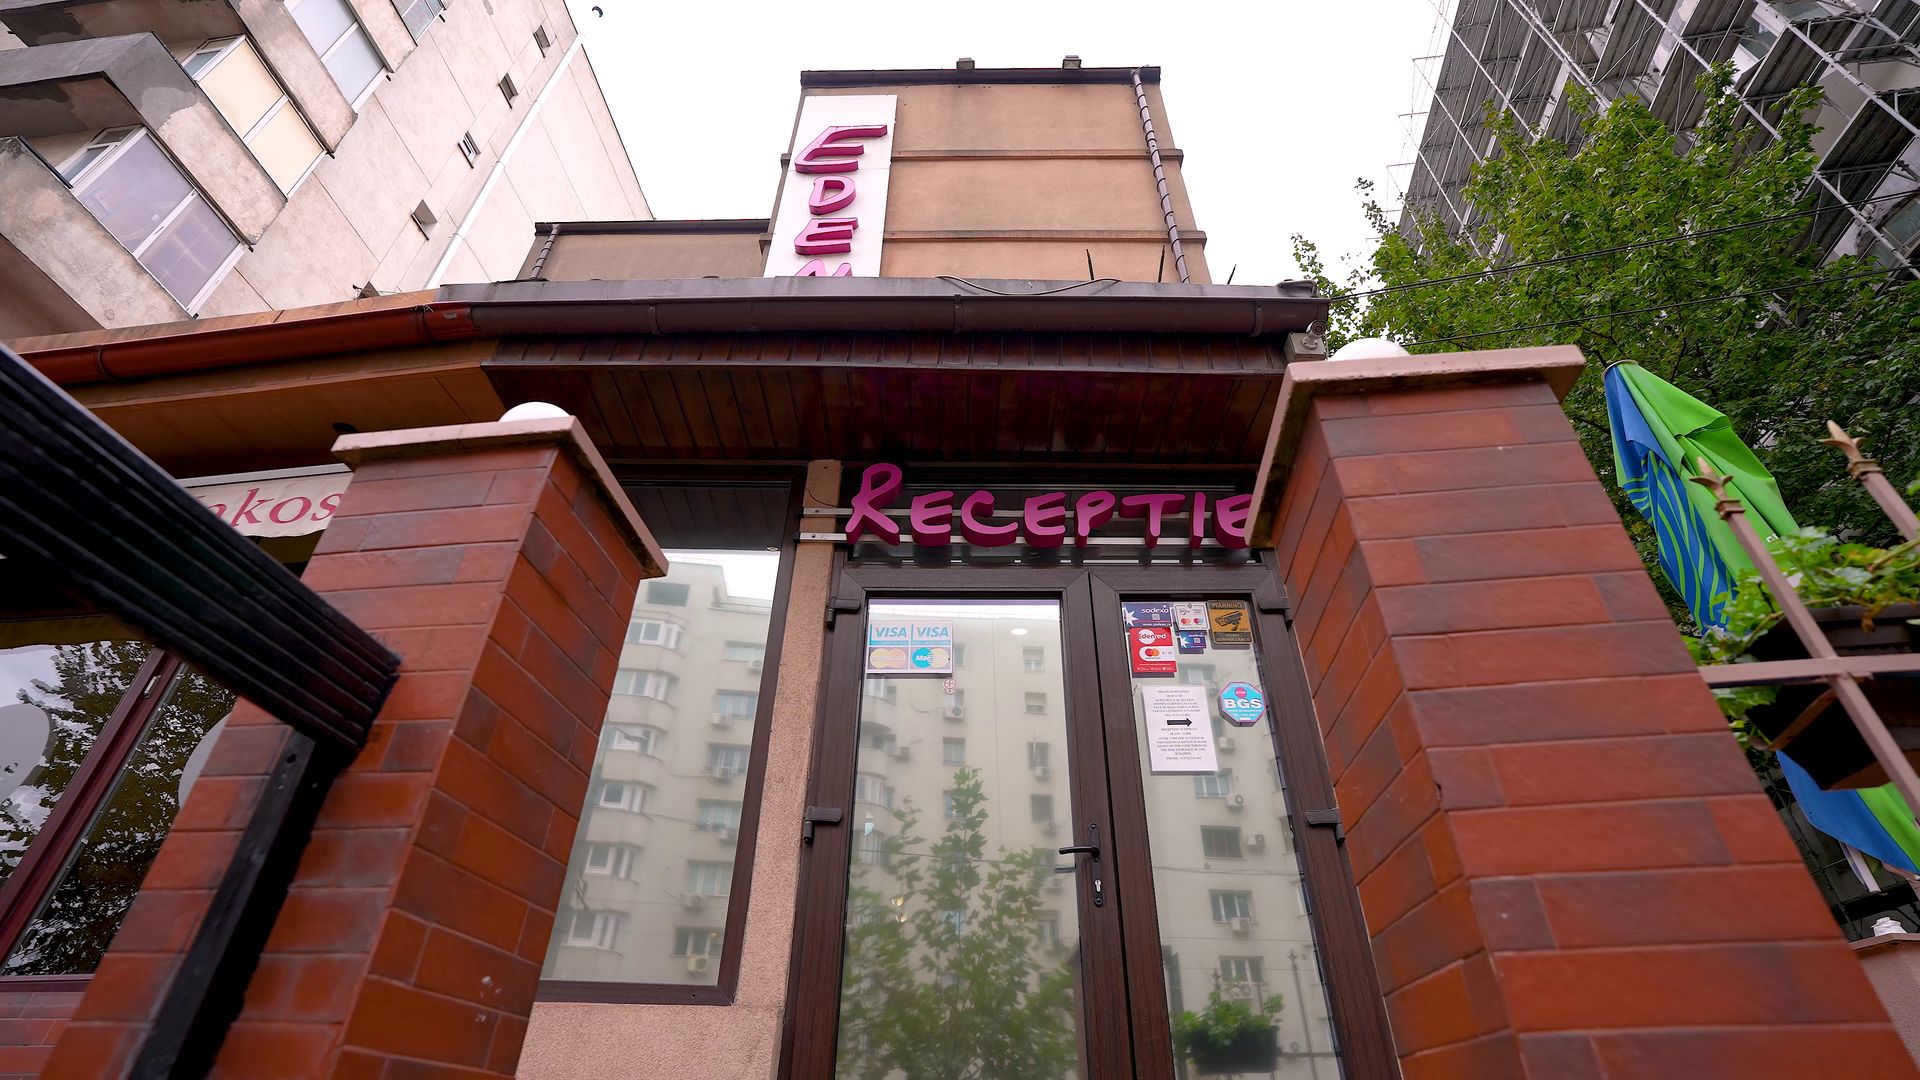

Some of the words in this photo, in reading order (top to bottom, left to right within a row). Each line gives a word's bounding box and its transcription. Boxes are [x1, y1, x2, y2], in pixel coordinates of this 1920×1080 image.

[197, 487, 344, 527] kos
[845, 463, 1253, 549] RECEPTIE
[875, 627, 907, 637] VISA
[917, 627, 949, 637] VISA
[1223, 698, 1262, 708] BGS
